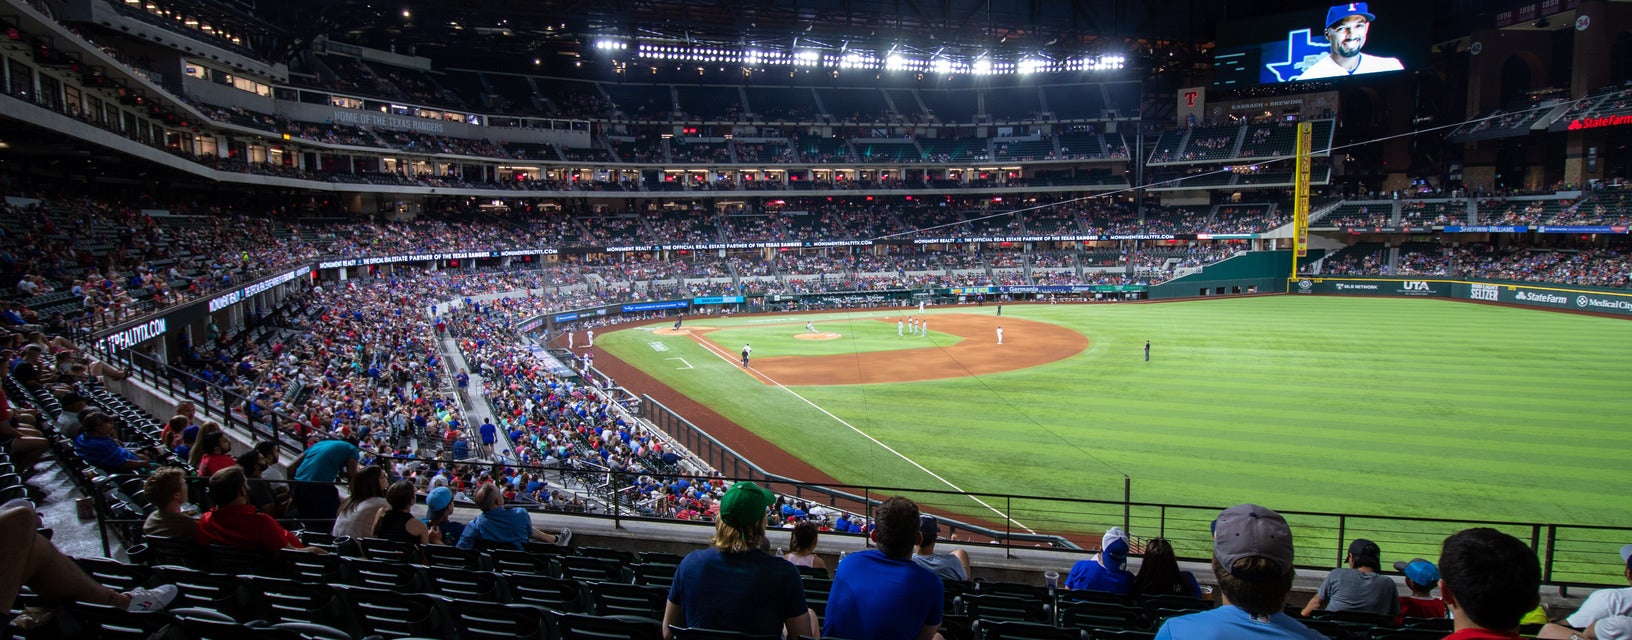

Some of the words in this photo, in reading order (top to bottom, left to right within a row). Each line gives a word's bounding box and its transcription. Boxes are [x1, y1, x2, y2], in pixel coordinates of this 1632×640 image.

[1576, 18, 1589, 28] 34
[1184, 91, 1198, 107] T
[334, 111, 358, 121] HOME
[360, 114, 370, 124] OF
[372, 116, 386, 126] THE
[389, 118, 411, 128] TEXAS
[412, 120, 444, 133] RANGERS
[1403, 281, 1429, 290] UTA
[1470, 289, 1498, 301] SELTZER
[1589, 298, 1618, 308] Medical
